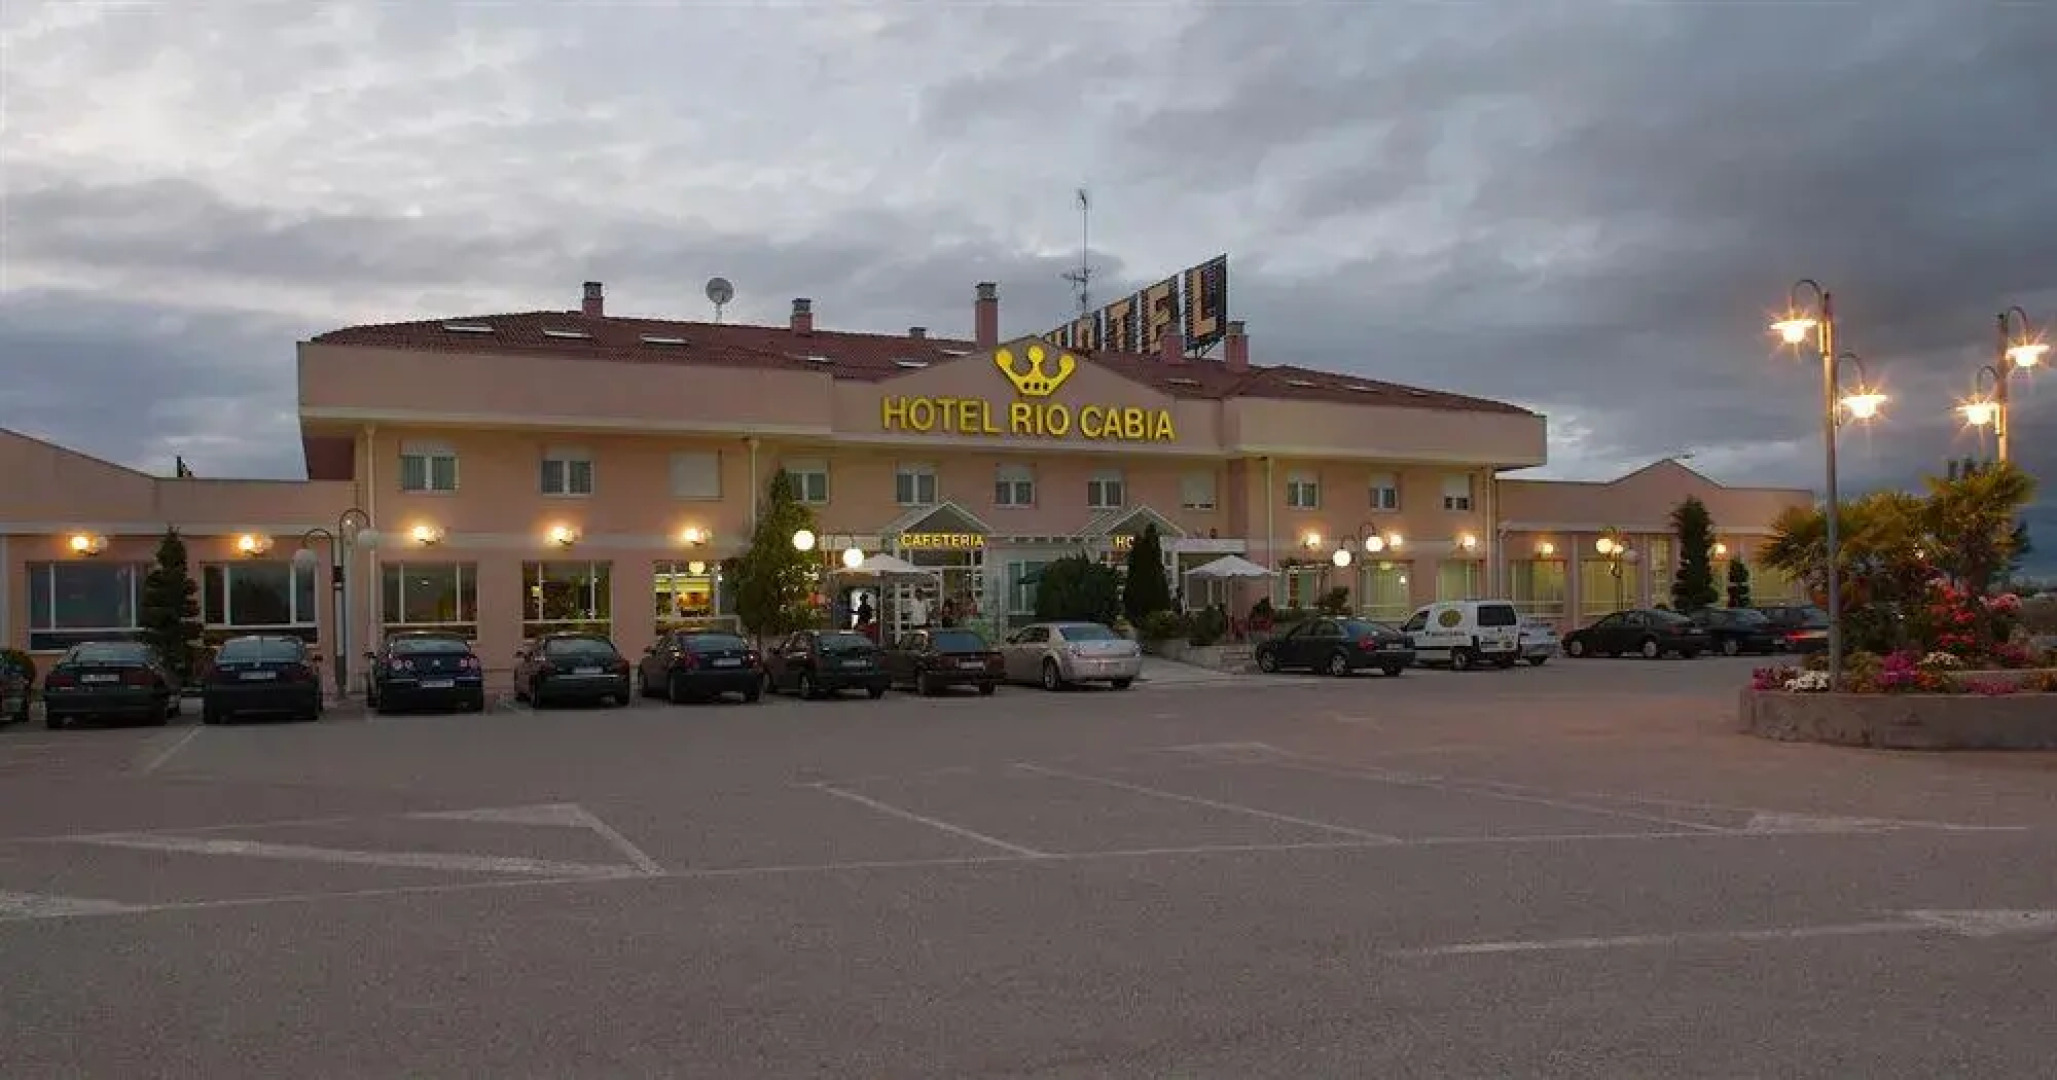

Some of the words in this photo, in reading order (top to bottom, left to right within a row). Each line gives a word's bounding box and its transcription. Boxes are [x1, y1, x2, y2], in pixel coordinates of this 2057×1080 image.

[1045, 269, 1217, 353] OTEL
[881, 396, 1000, 434] HOTEL
[1010, 402, 1070, 436] RIO
[1080, 405, 1175, 440] CABIA
[901, 534, 984, 547] CAFETERIA
